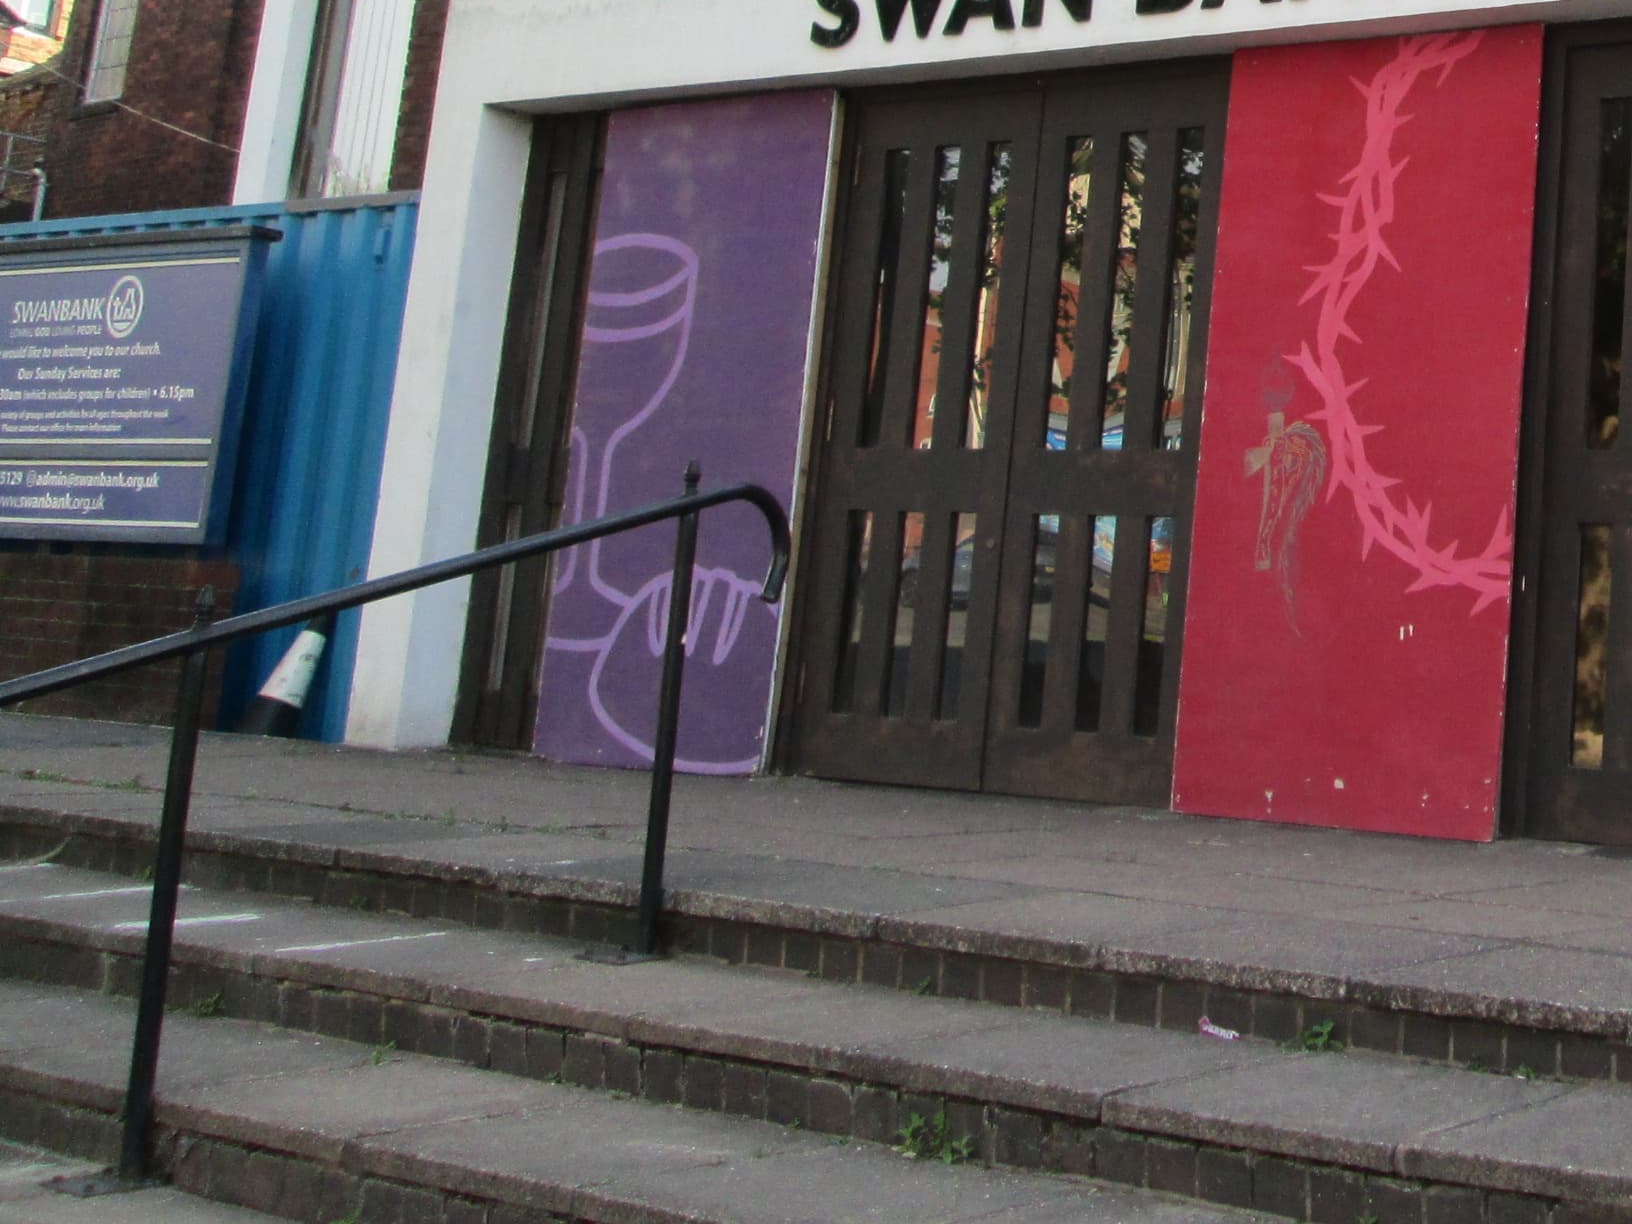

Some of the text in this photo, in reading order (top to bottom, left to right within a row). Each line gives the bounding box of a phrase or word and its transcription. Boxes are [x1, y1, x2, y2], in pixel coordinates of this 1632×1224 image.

[11, 297, 106, 324] SWANBANK
[17, 367, 34, 381] Our
[34, 366, 67, 382] Sunday
[66, 365, 103, 379] Services
